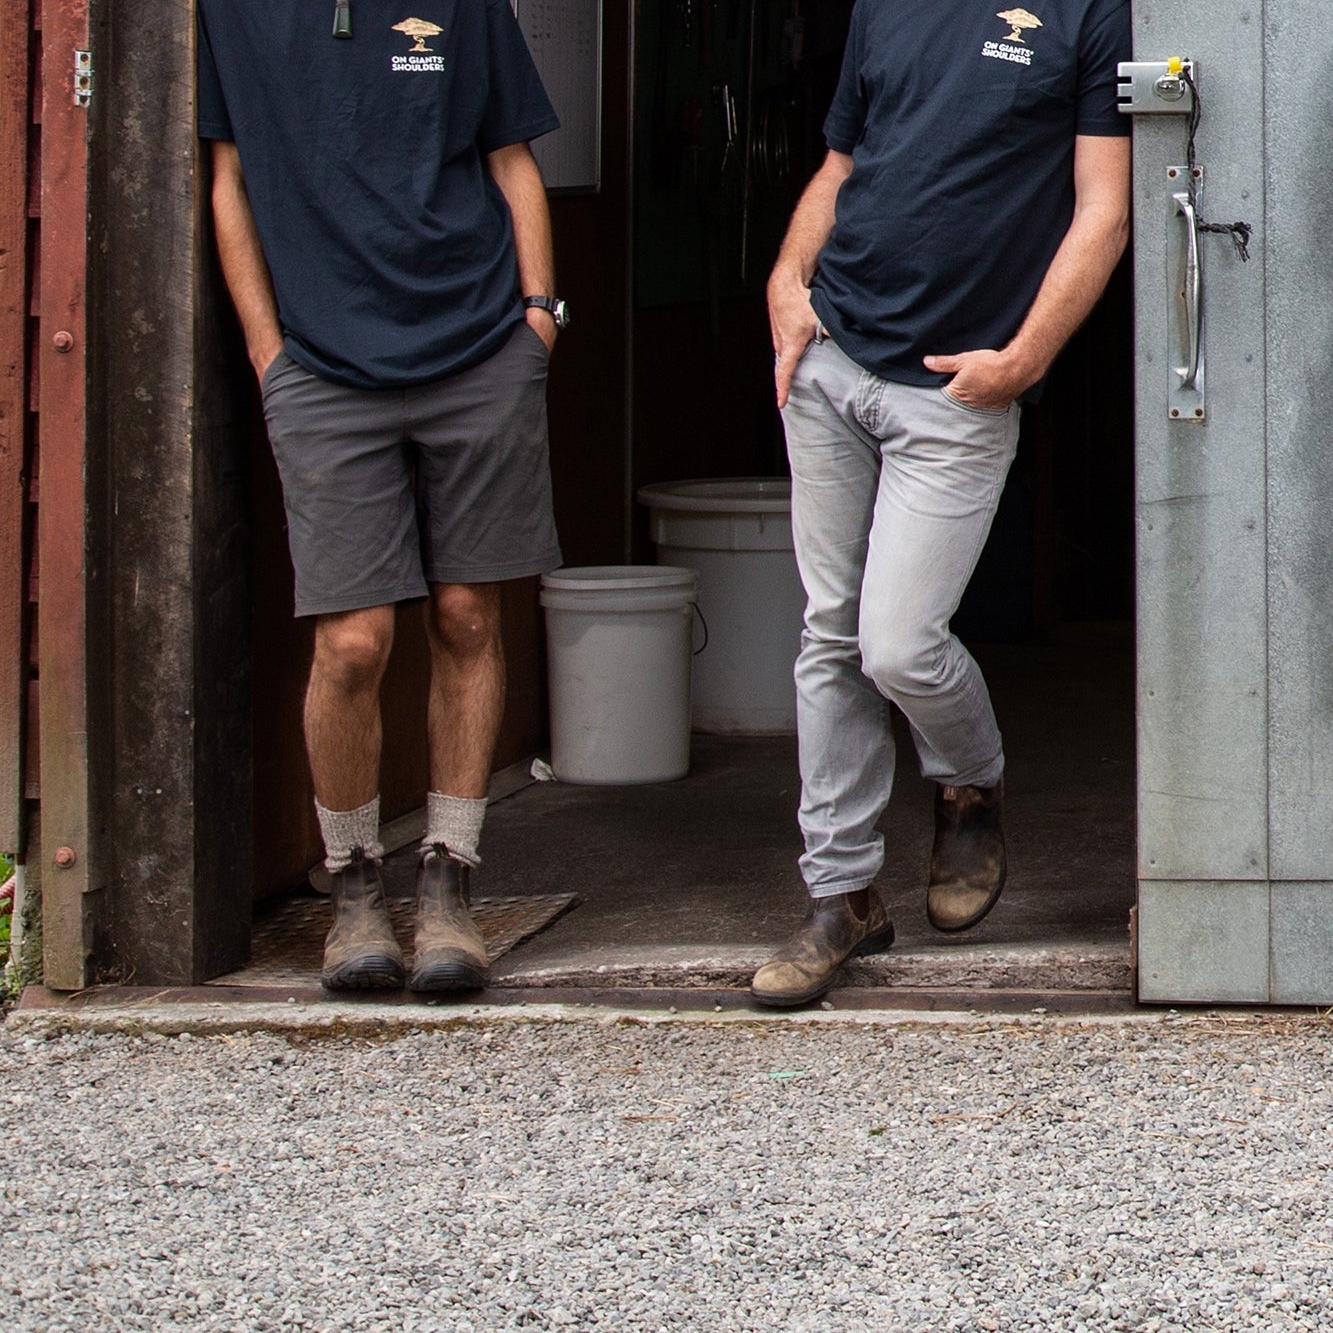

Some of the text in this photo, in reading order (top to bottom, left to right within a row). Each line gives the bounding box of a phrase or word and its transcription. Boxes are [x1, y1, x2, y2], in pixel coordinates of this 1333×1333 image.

[984, 41, 998, 50] ON
[391, 55, 407, 64] ON
[981, 48, 1032, 66] SHOULDERS
[391, 63, 445, 72] SHOULDERS
